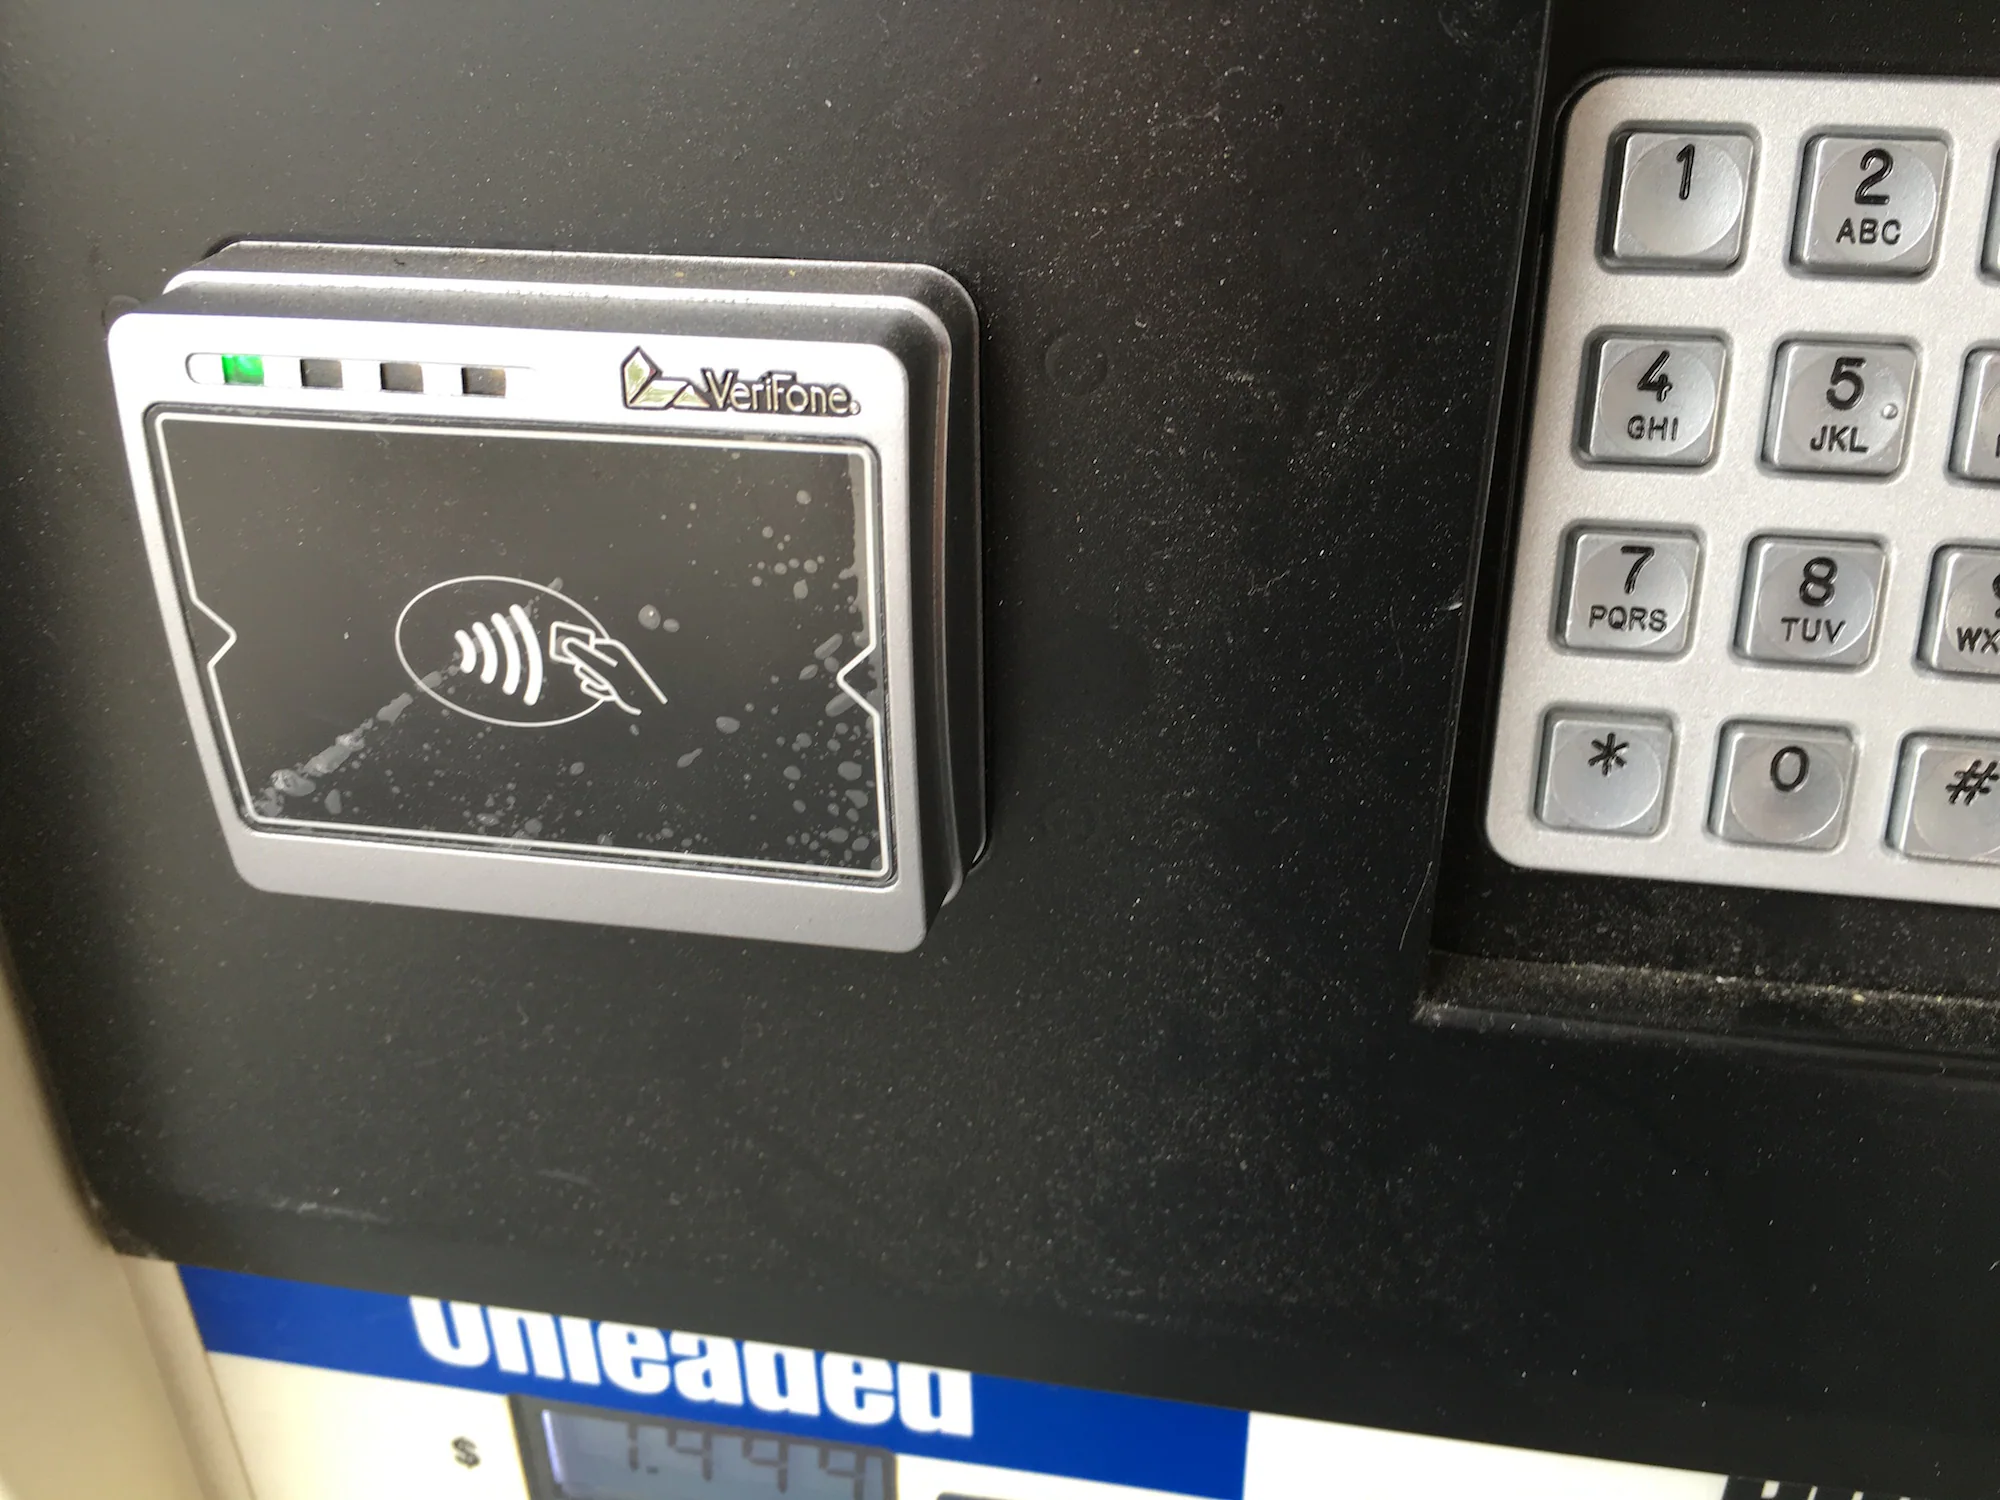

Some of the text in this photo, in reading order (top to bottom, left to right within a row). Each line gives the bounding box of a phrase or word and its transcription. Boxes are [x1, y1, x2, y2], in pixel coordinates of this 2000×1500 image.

[1675, 143, 1696, 200] 1
[1854, 148, 1894, 206] 2
[1836, 218, 1902, 246] ABC
[701, 368, 857, 417] VeriFone
[1636, 350, 1673, 402] 4
[1825, 356, 1867, 411] 5
[1627, 414, 1680, 441] GHI
[1810, 424, 1869, 454] JKL
[1620, 545, 1655, 595] 7
[1799, 555, 1839, 607] 8
[1588, 604, 1668, 633] PQRS
[1780, 617, 1847, 645] TUV
[1956, 626, 2000, 654] WX
[1945, 759, 2000, 807] #
[408, 1294, 974, 1437] Unleaded
[451, 1436, 481, 1468] $
